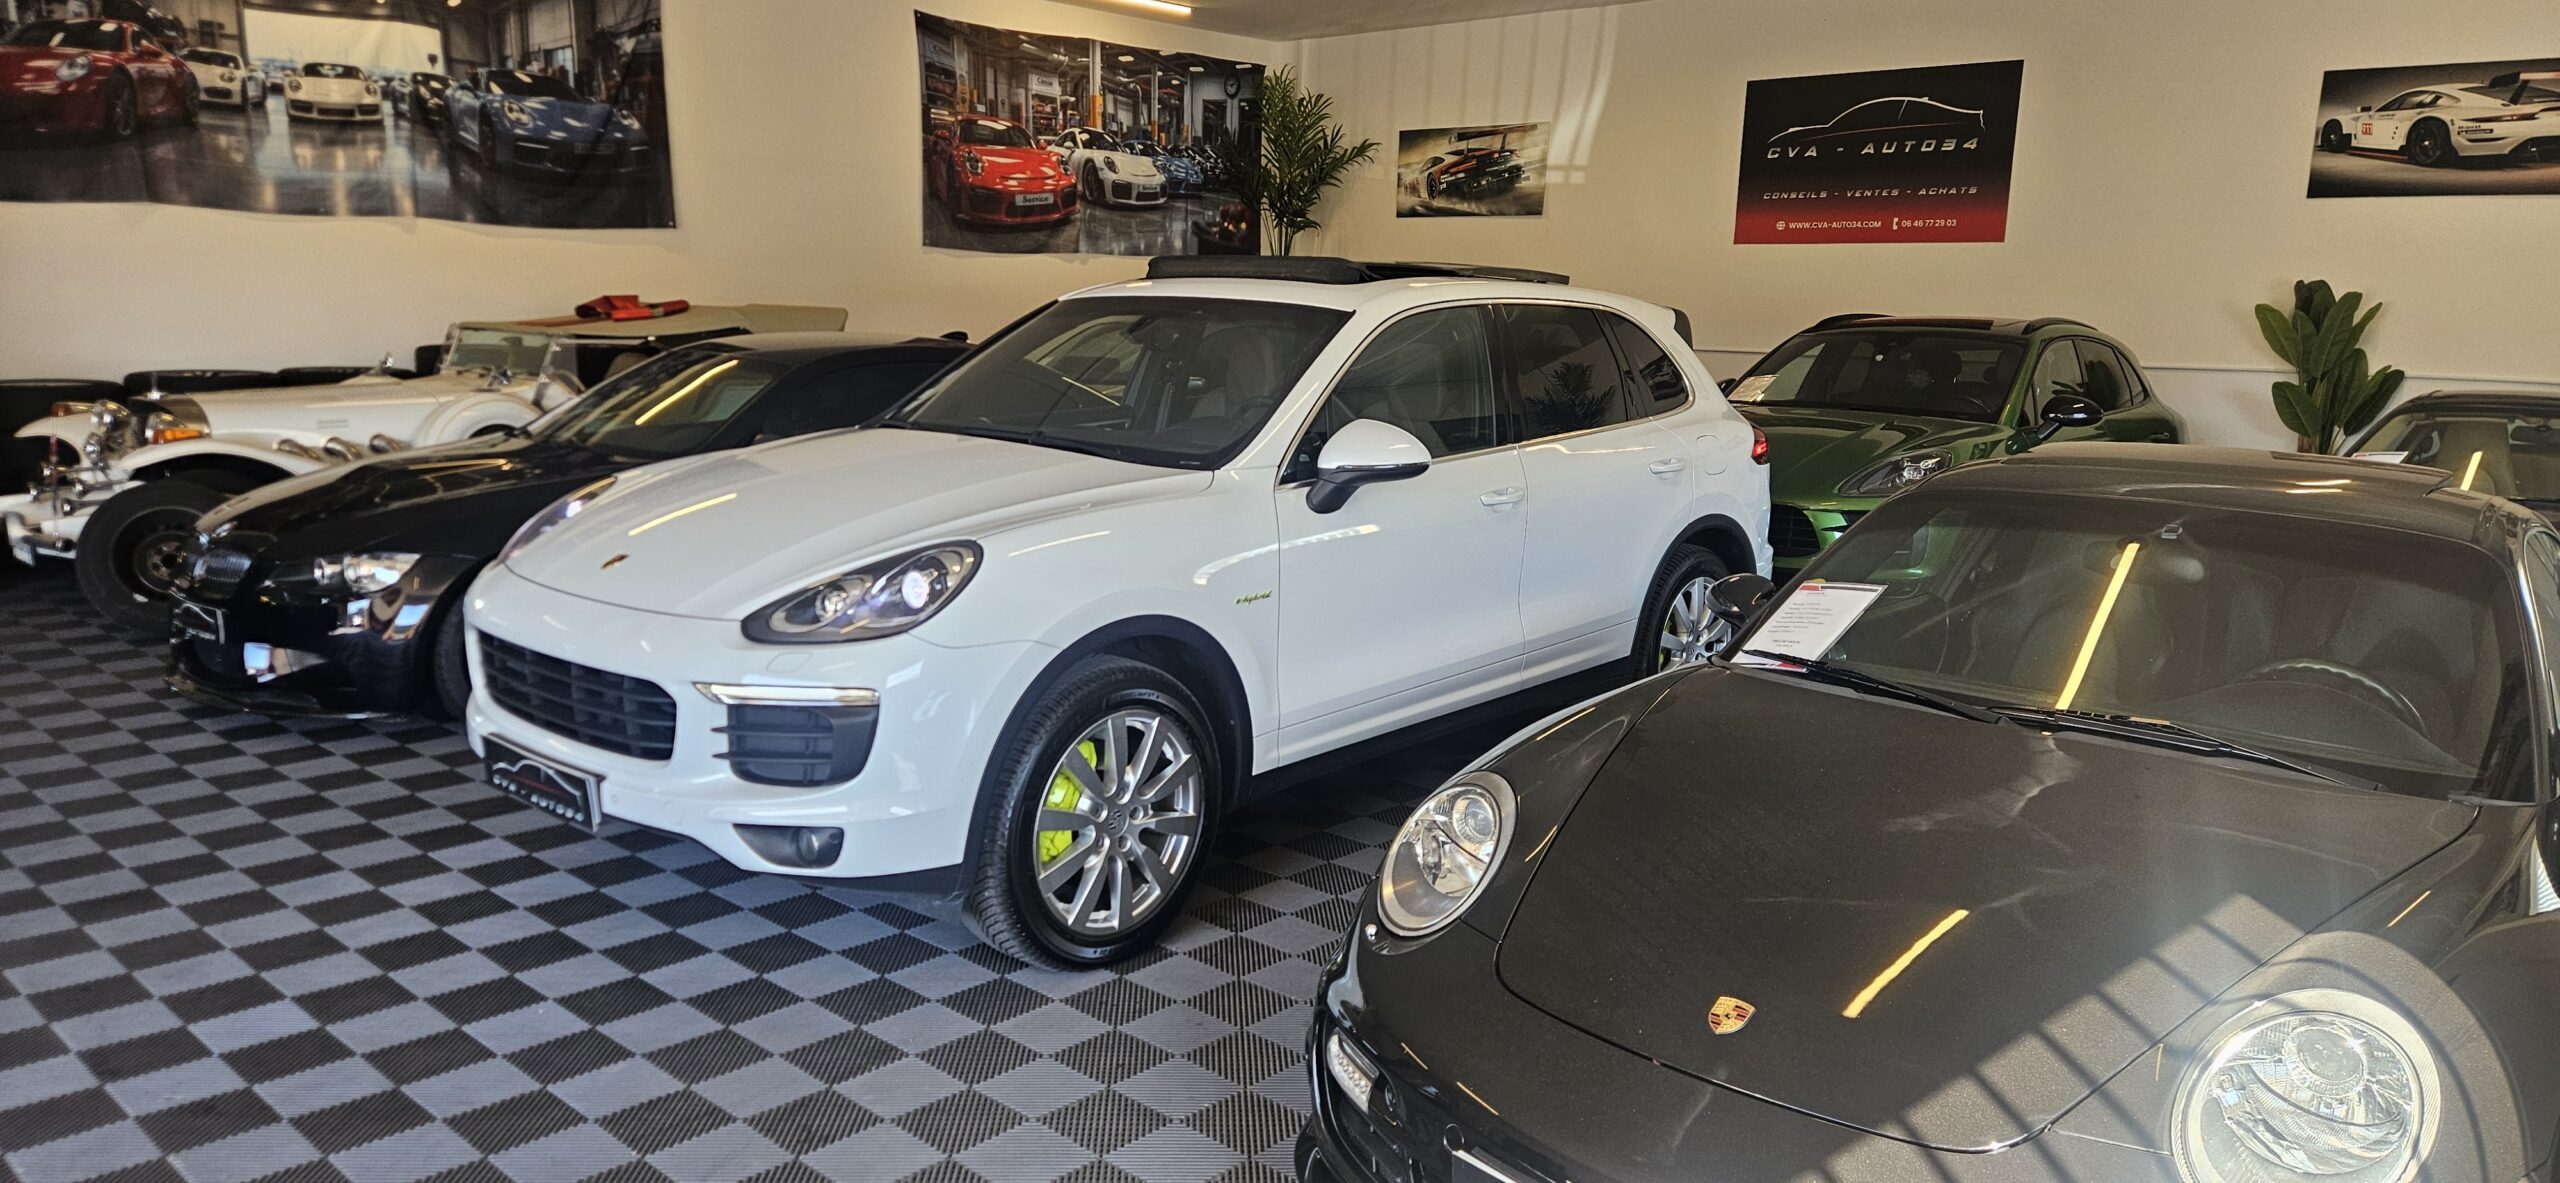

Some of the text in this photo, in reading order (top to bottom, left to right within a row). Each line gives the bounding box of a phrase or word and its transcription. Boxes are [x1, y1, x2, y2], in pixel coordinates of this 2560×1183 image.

[1767, 145, 1817, 159] CVA
[1861, 137, 1979, 155] AUTO34
[1763, 190, 1828, 199] CONSEILS
[1846, 188, 1900, 197] VENTES
[1918, 186, 1979, 196] ACHATS
[1788, 221, 1882, 229] WWW.CVA-AUTO34.COM
[1901, 220, 1912, 228] 06
[1946, 219, 1957, 227] 03
